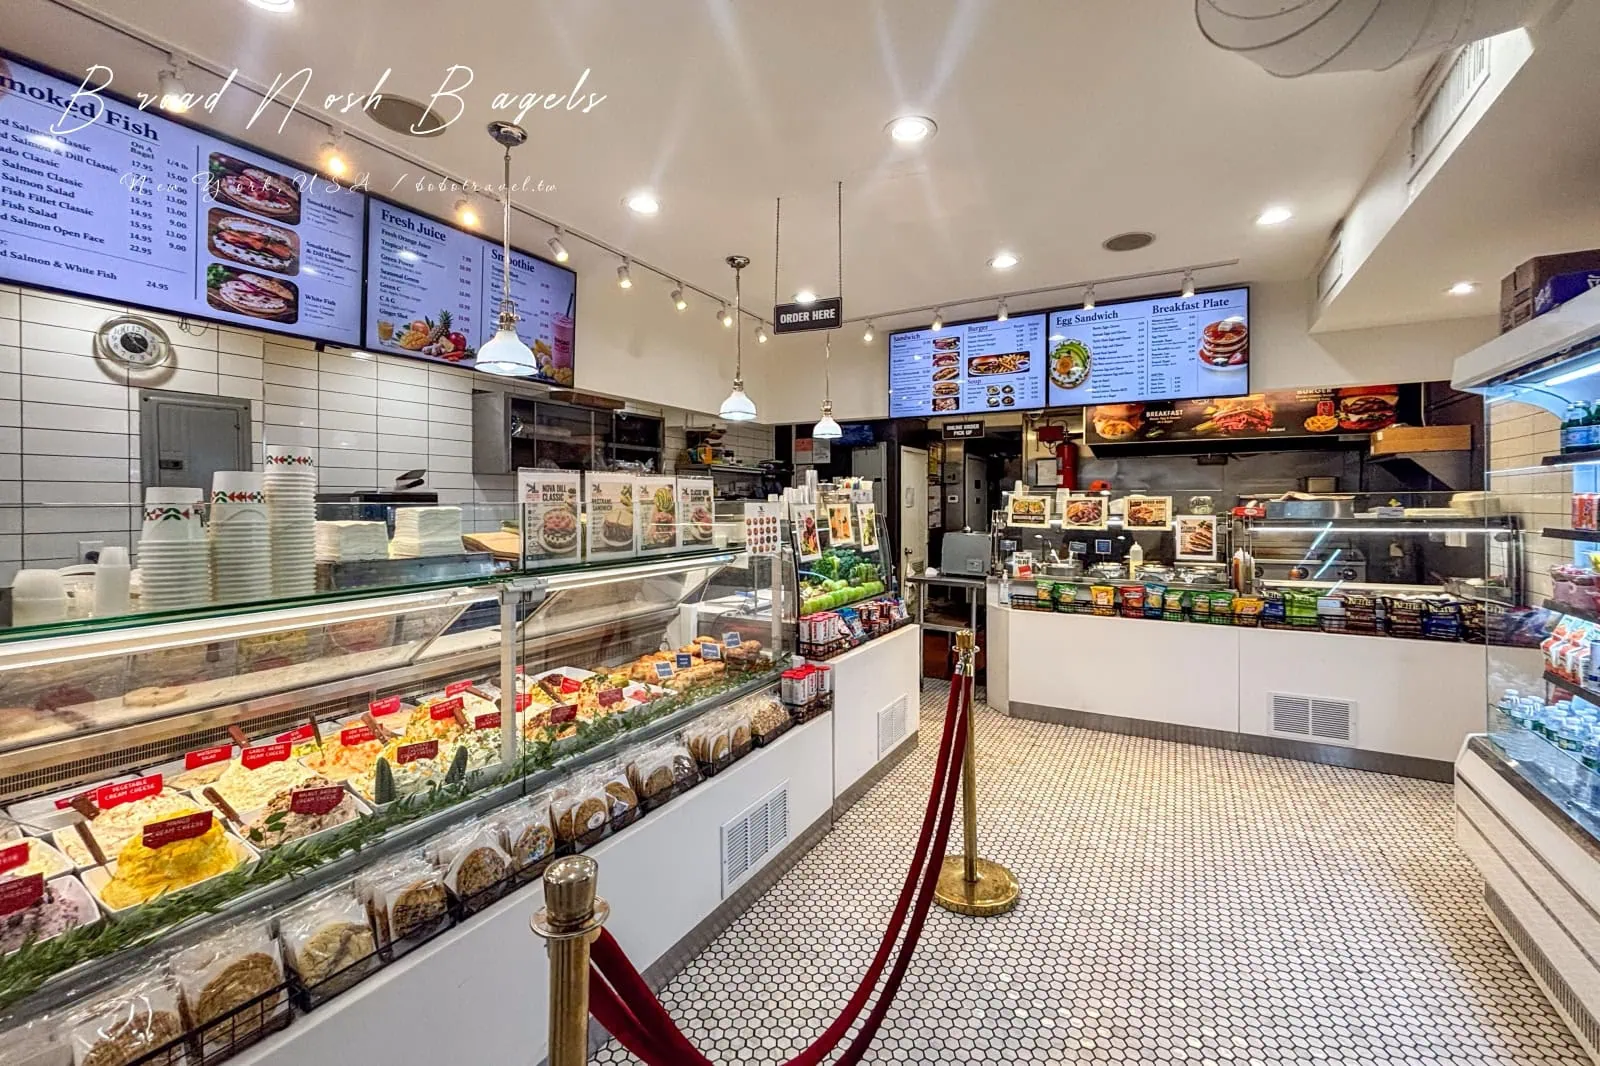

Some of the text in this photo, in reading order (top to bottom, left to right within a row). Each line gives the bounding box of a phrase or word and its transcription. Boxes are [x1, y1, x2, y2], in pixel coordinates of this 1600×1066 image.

[105, 109, 160, 141] Fish
[56, 135, 92, 152] Classic
[131, 141, 144, 150] On
[130, 147, 155, 159] Bagel
[22, 151, 60, 168] Classic
[65, 151, 84, 163] Dill
[86, 158, 119, 174] Classic
[132, 160, 153, 172] 17.95
[2, 159, 84, 188] Salmon Classic
[167, 171, 188, 183] 15.00
[1, 172, 75, 198] Salmon Salad
[1, 186, 94, 216] Fish Fillet Classic
[130, 196, 153, 208] 15.95
[1, 199, 57, 219] Fish Salad
[130, 208, 152, 220] 14.95
[10, 215, 105, 244] Salmon Open Face
[130, 220, 152, 231] 15.95
[169, 219, 187, 229] 9.00
[381, 208, 447, 242] Fresh Juice
[129, 232, 152, 243] 14.95
[381, 228, 398, 238] Fresh
[398, 234, 417, 245] Orange
[129, 244, 152, 255] 22.95
[168, 242, 187, 252] 9.00
[381, 238, 403, 250] Tropical
[380, 253, 397, 263] Green
[10, 251, 51, 266] Salmon
[65, 263, 95, 275] White
[97, 270, 117, 280] Fish
[146, 280, 169, 291] 24.95
[380, 282, 395, 290] Green
[1152, 298, 1229, 314] Breakfast Plate
[780, 309, 835, 324] ORDER HERE
[1056, 310, 1119, 326] Egg Sandwich
[968, 325, 988, 333] Burger
[1146, 409, 1183, 417] BREAKFAST
[542, 484, 567, 492] NOVA DILL
[542, 493, 564, 501] CLASSIC
[111, 779, 148, 792] VEGETABLE
[104, 783, 155, 801] CREAM CHEESE
[166, 817, 191, 826] MANGO
[151, 821, 204, 837] CREAM CHEESE
